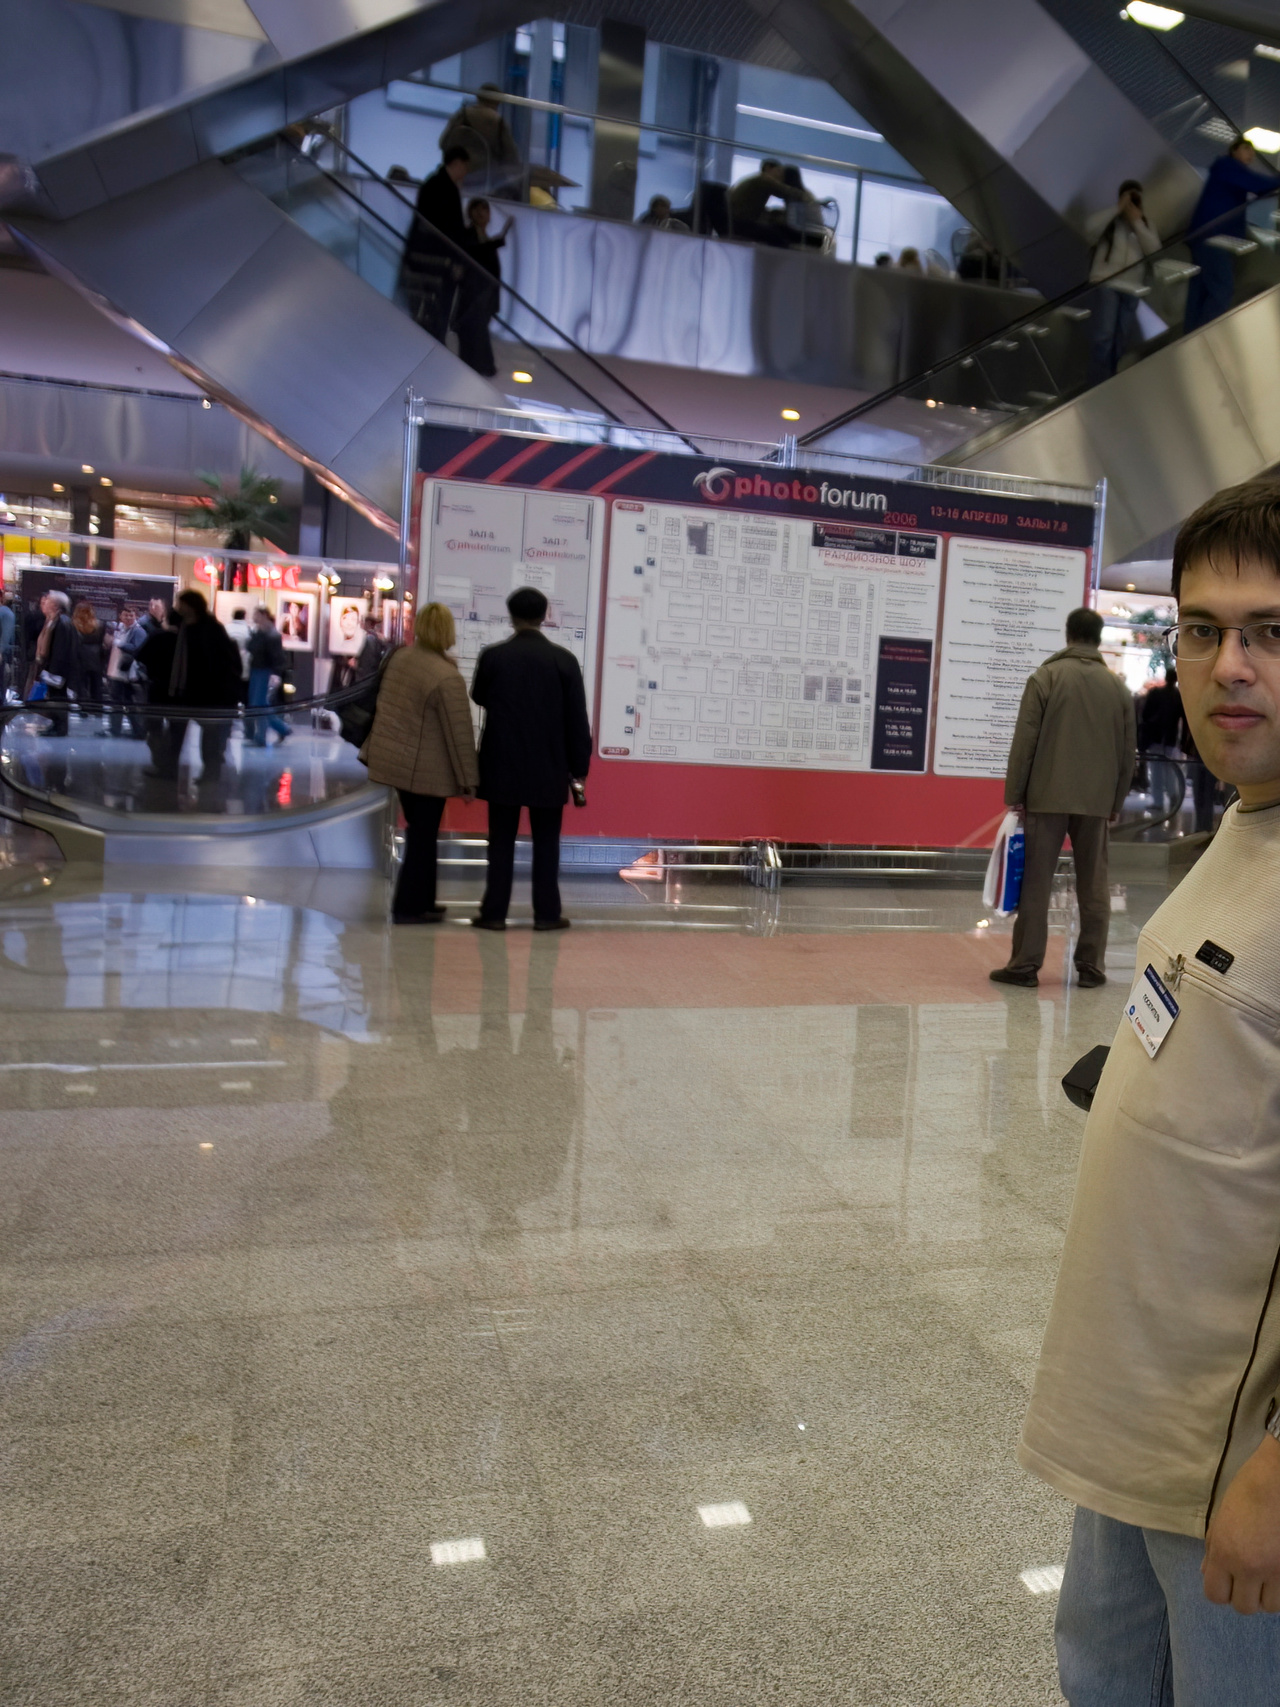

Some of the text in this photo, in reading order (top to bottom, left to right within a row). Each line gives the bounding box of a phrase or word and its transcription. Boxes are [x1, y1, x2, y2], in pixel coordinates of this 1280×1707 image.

[734, 473, 888, 511] photoforum
[883, 511, 918, 528] 2006
[961, 510, 1009, 526] АПРЕЛЯ
[1015, 515, 1051, 531] ЗАЛЫ
